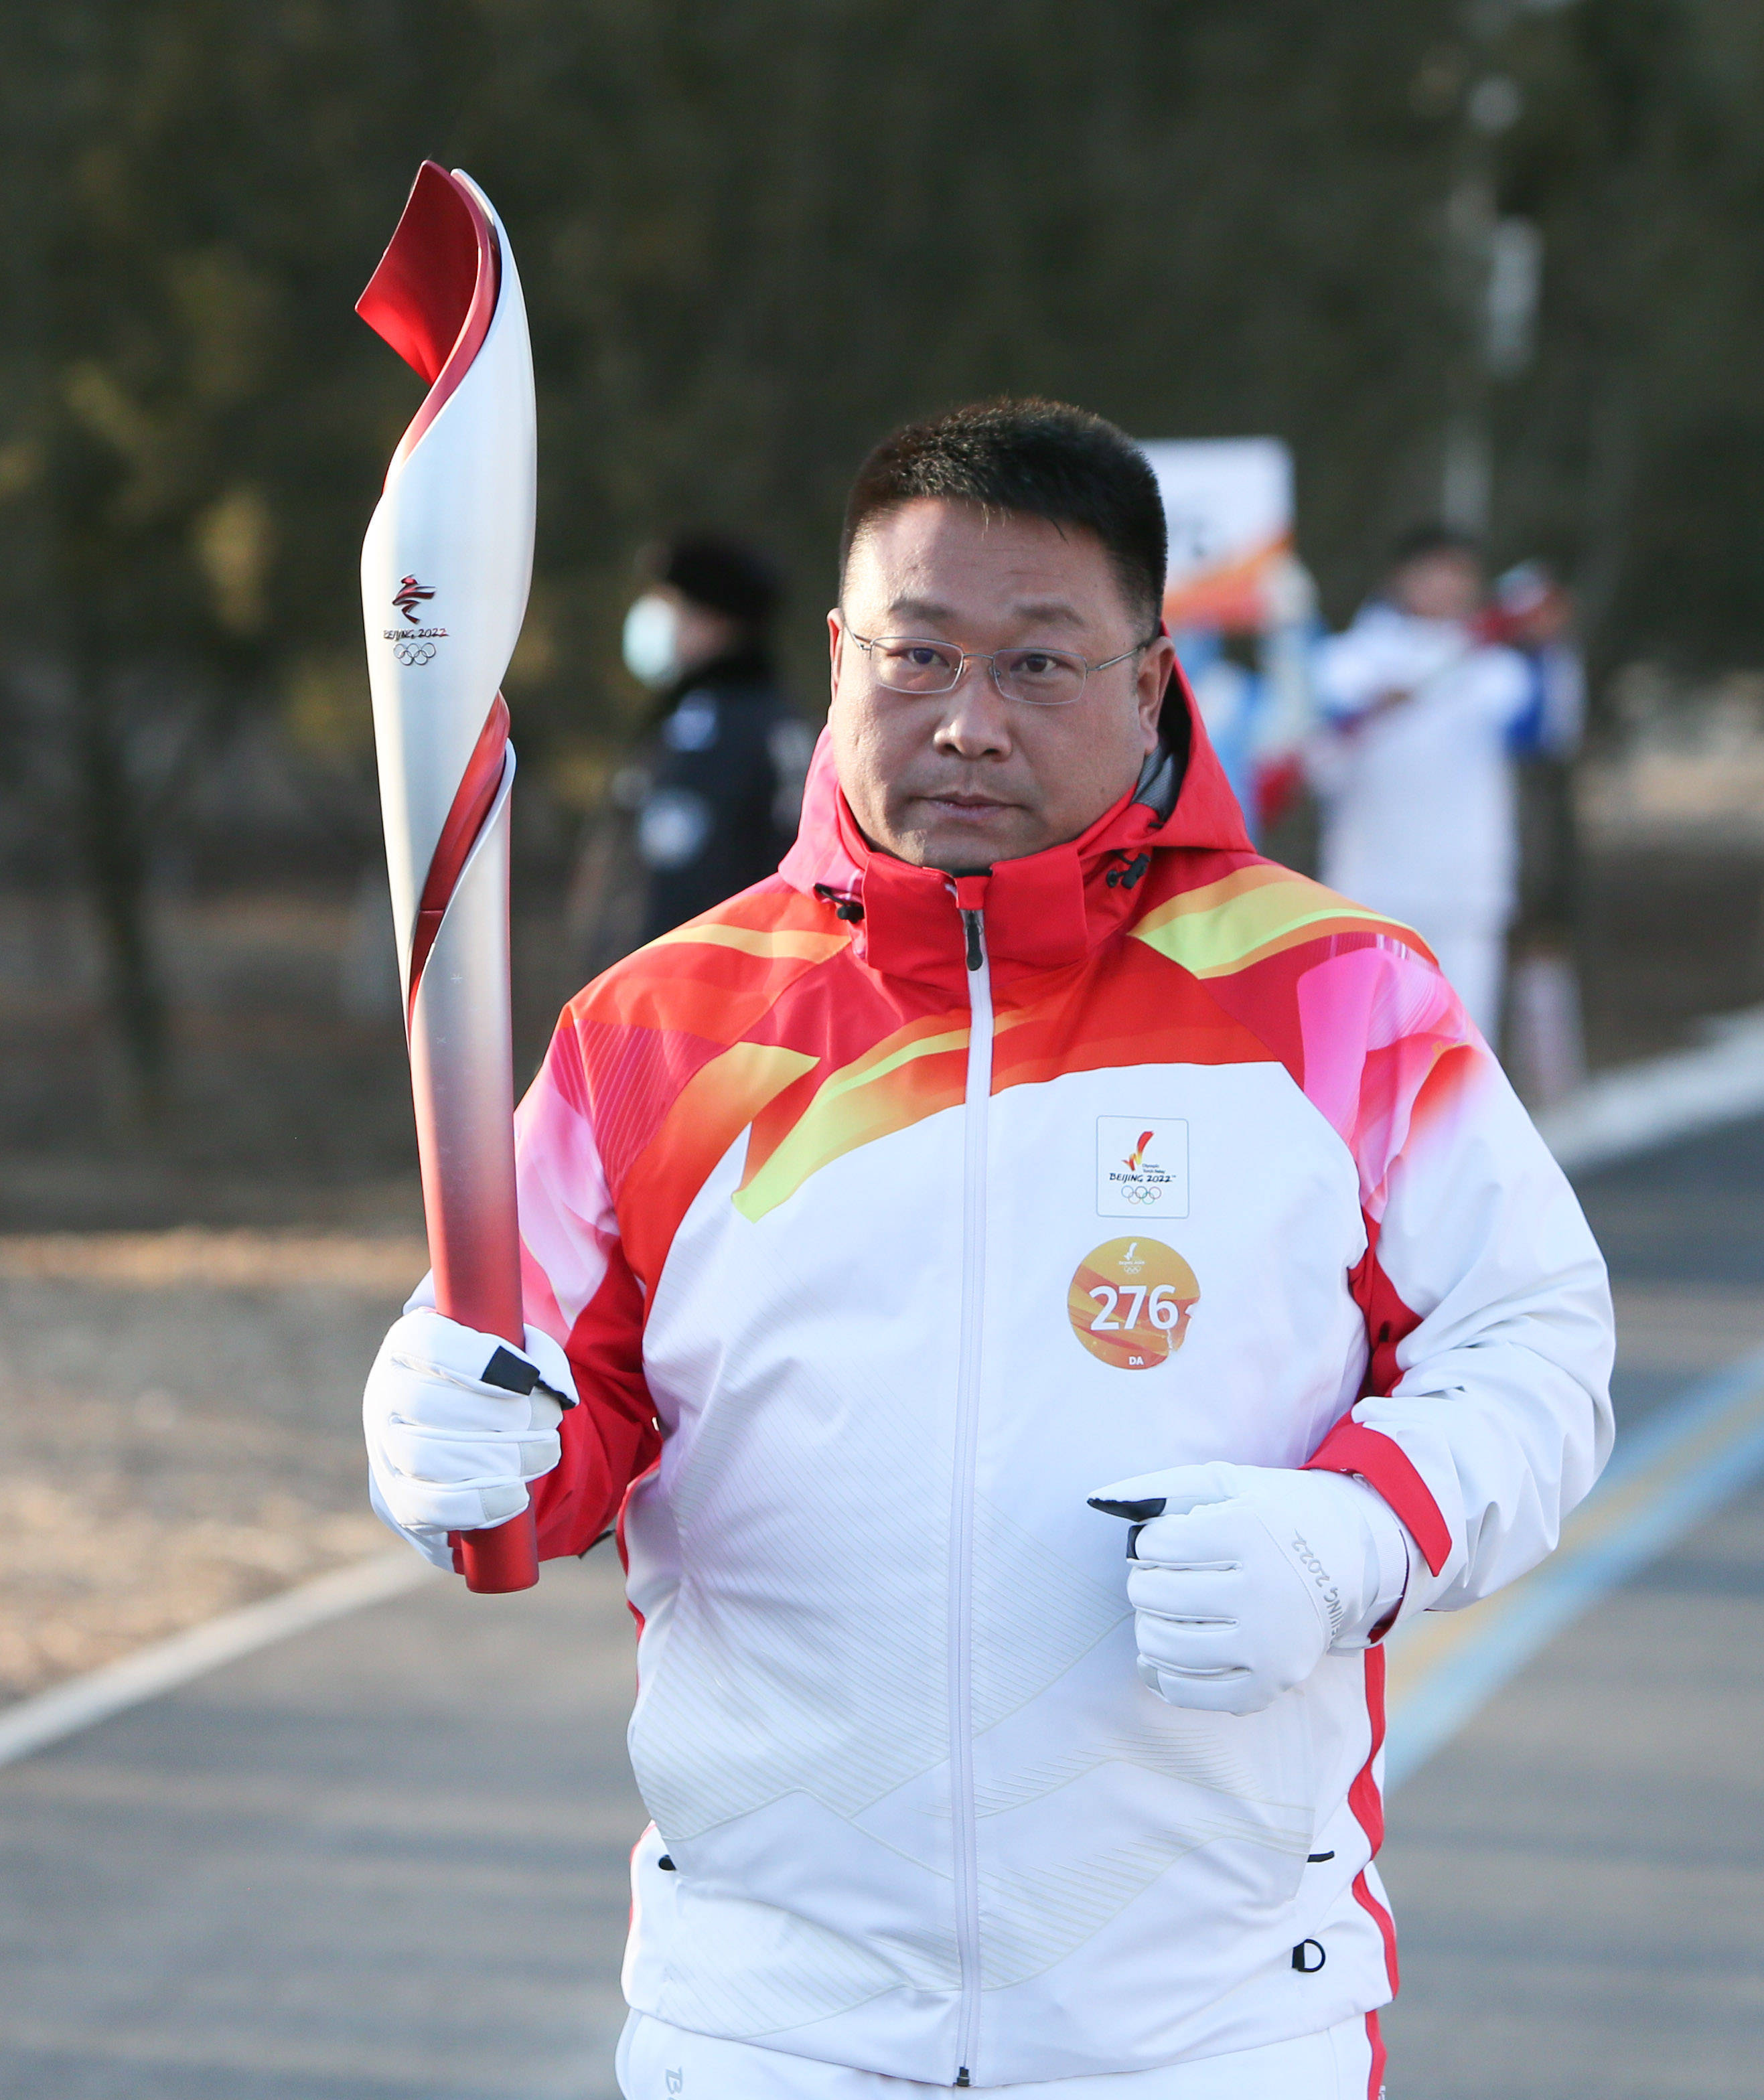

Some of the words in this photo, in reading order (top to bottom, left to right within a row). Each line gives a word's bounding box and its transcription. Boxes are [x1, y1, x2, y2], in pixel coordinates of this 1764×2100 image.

[418, 627, 449, 638] 2022
[1109, 1173, 1143, 1183] BEIJING
[1089, 1284, 1179, 1331] 276
[1128, 1356, 1144, 1365] DA
[1292, 1527, 1329, 1588] 2022
